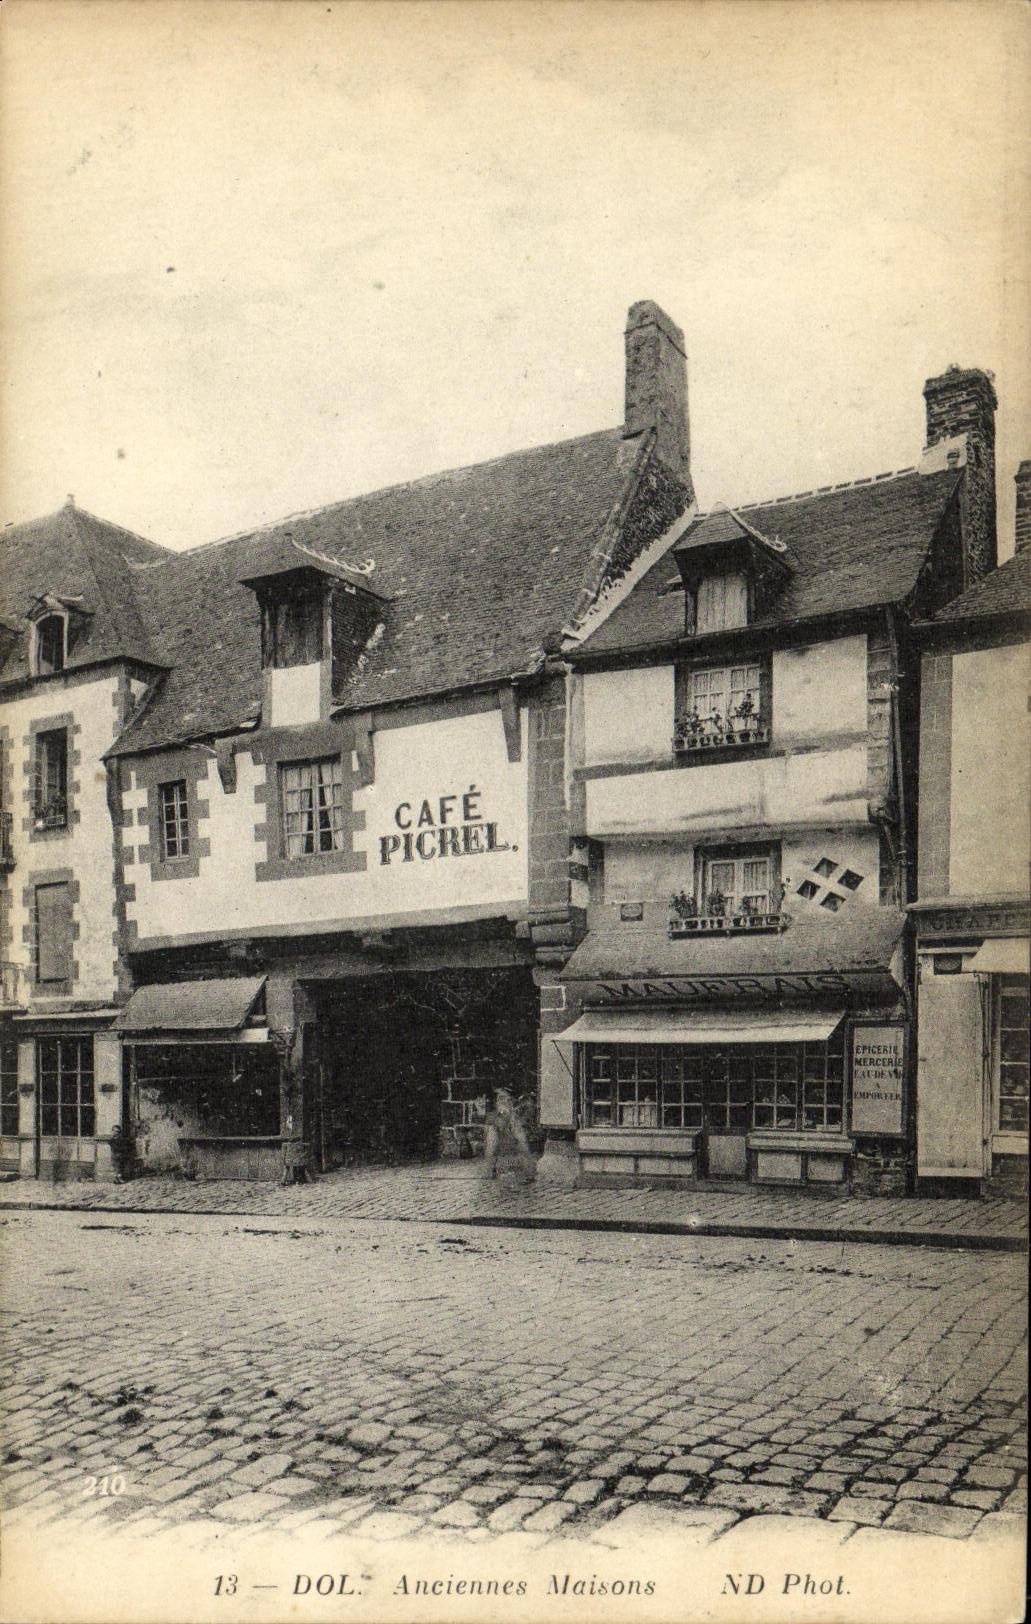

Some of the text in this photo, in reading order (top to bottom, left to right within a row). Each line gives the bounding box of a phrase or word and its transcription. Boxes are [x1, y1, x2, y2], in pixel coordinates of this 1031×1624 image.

[395, 784, 482, 830] CAFÉ
[379, 822, 519, 865] PICREL.
[854, 1057, 904, 1067] MERCERIE
